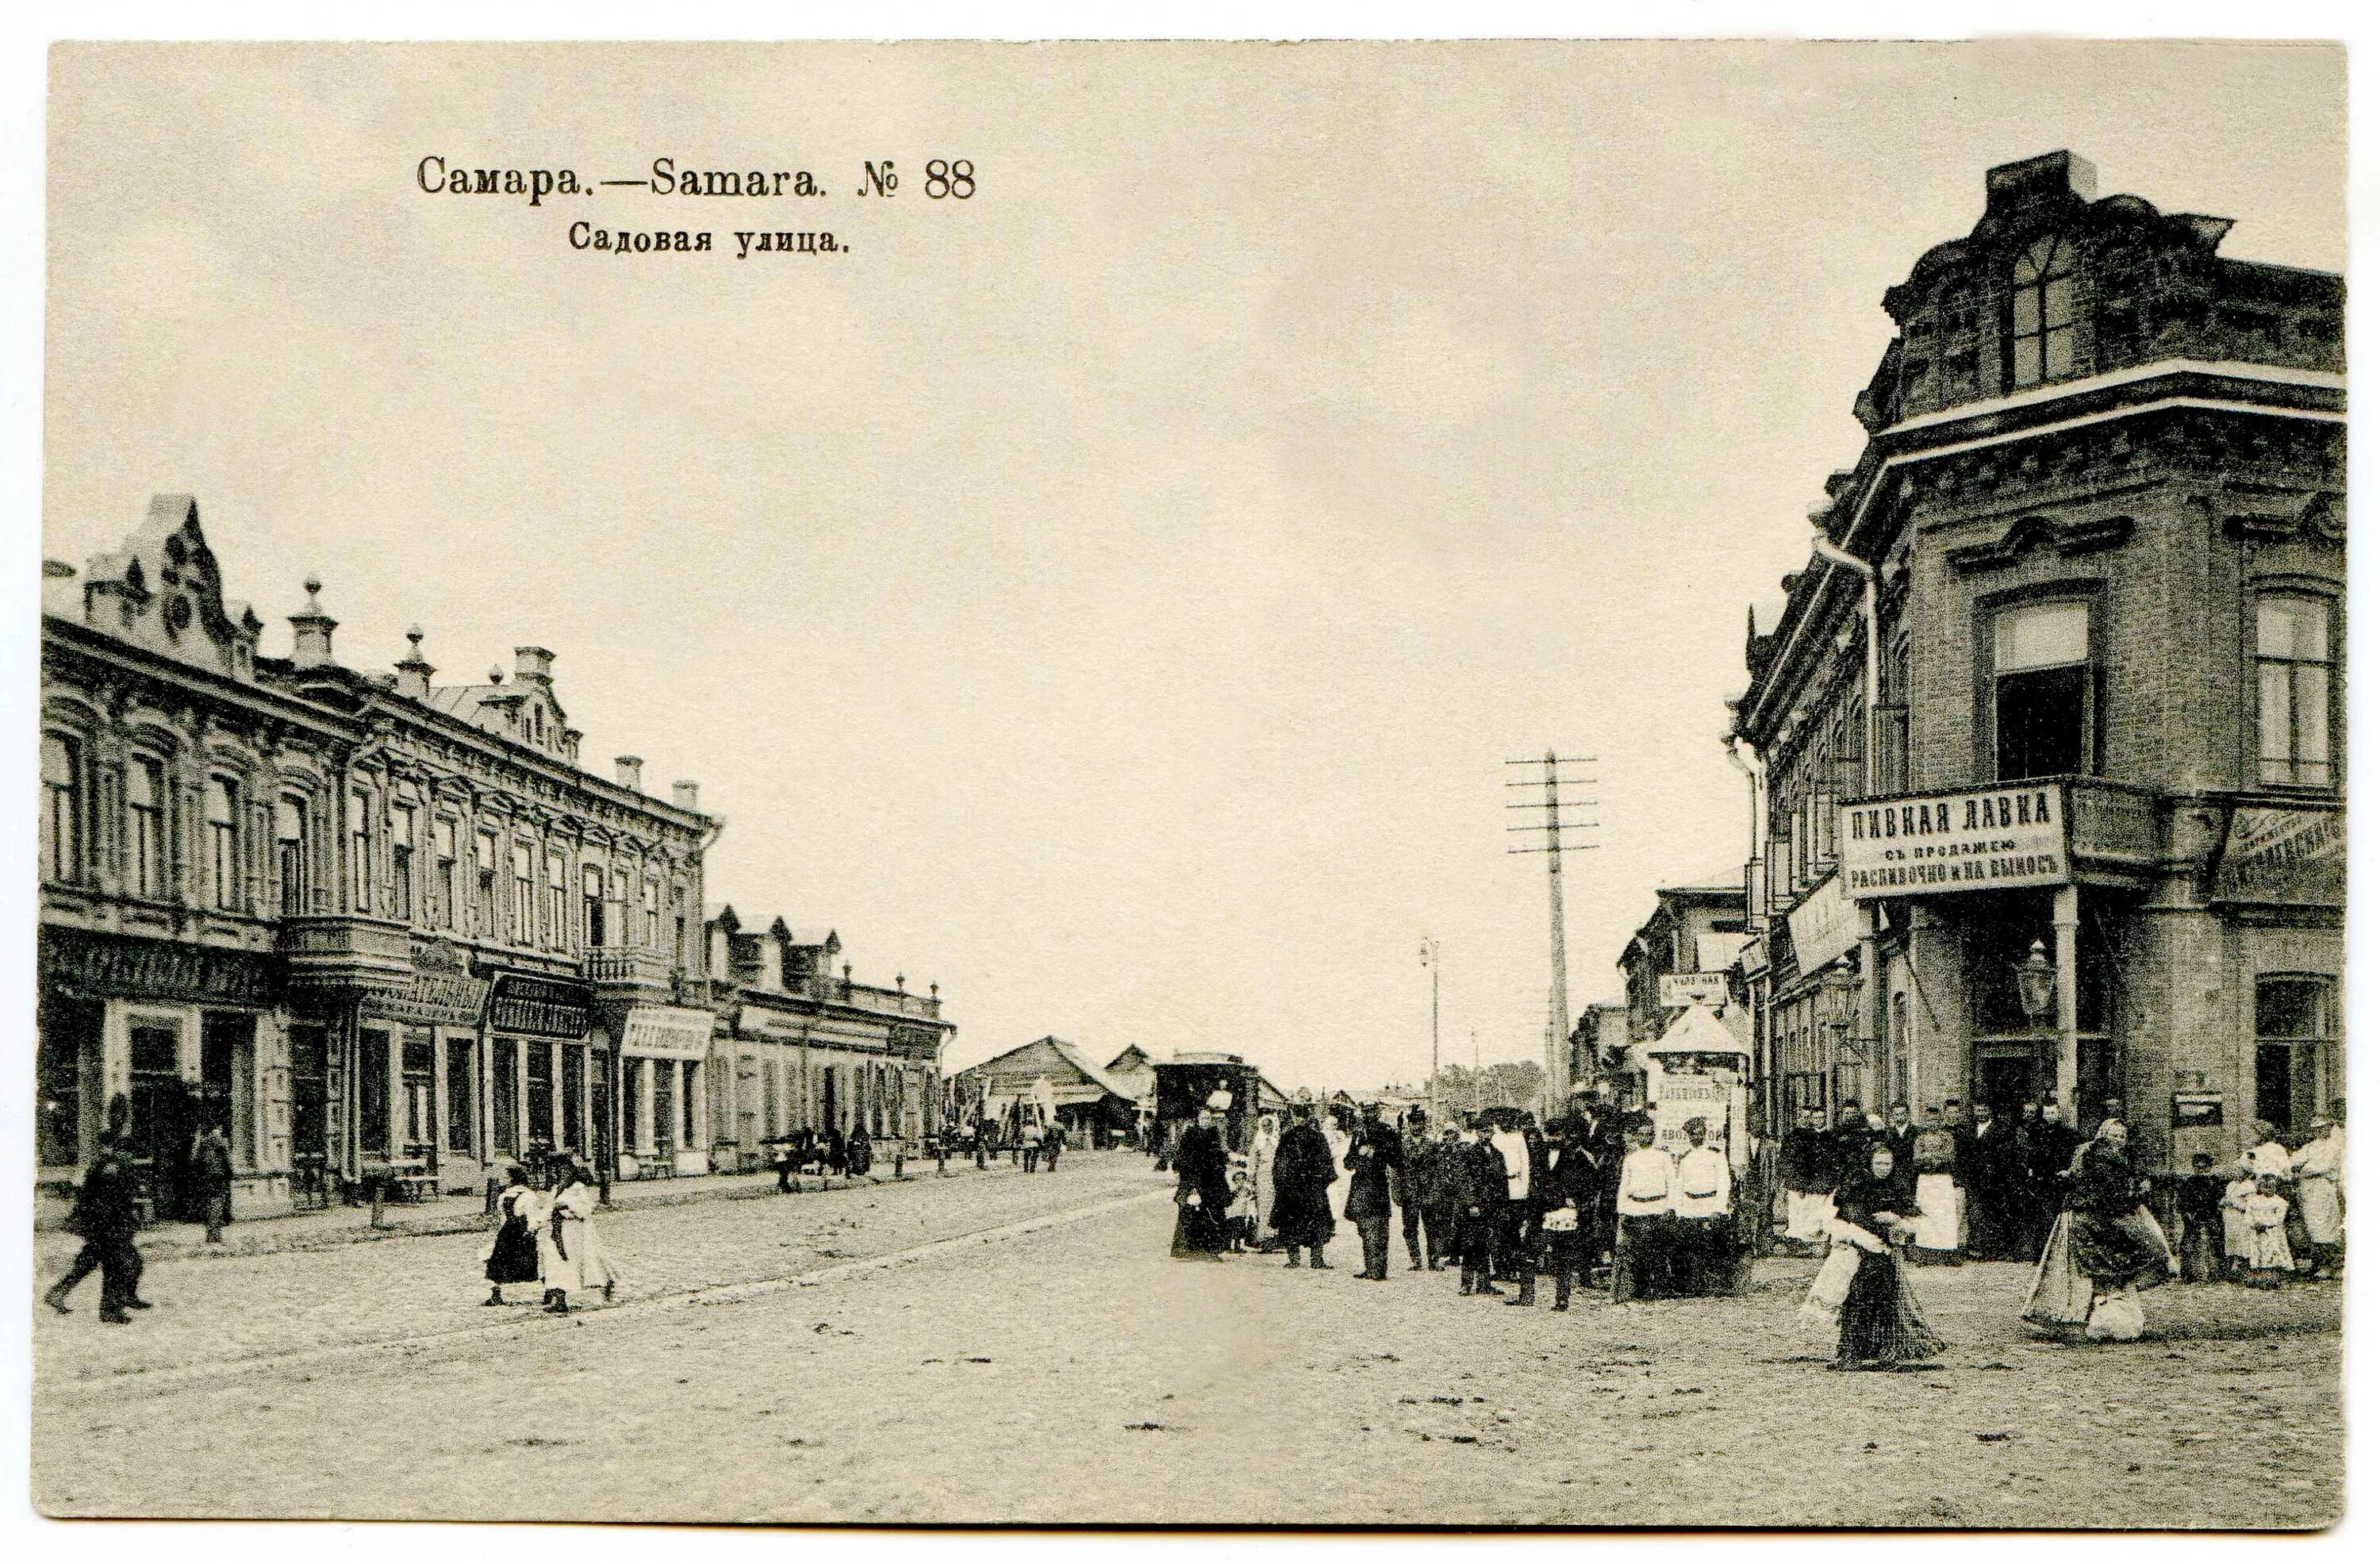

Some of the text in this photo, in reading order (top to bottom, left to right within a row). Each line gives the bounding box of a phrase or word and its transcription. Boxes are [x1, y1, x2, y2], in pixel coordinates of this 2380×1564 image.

[1851, 792, 2051, 839] ПИВНАЯ ЛАВКА
[1851, 864, 1947, 889] РАСПИВОЧНО
[1964, 860, 1983, 880] НА
[1990, 854, 2059, 878] ВЫНОСЪ
